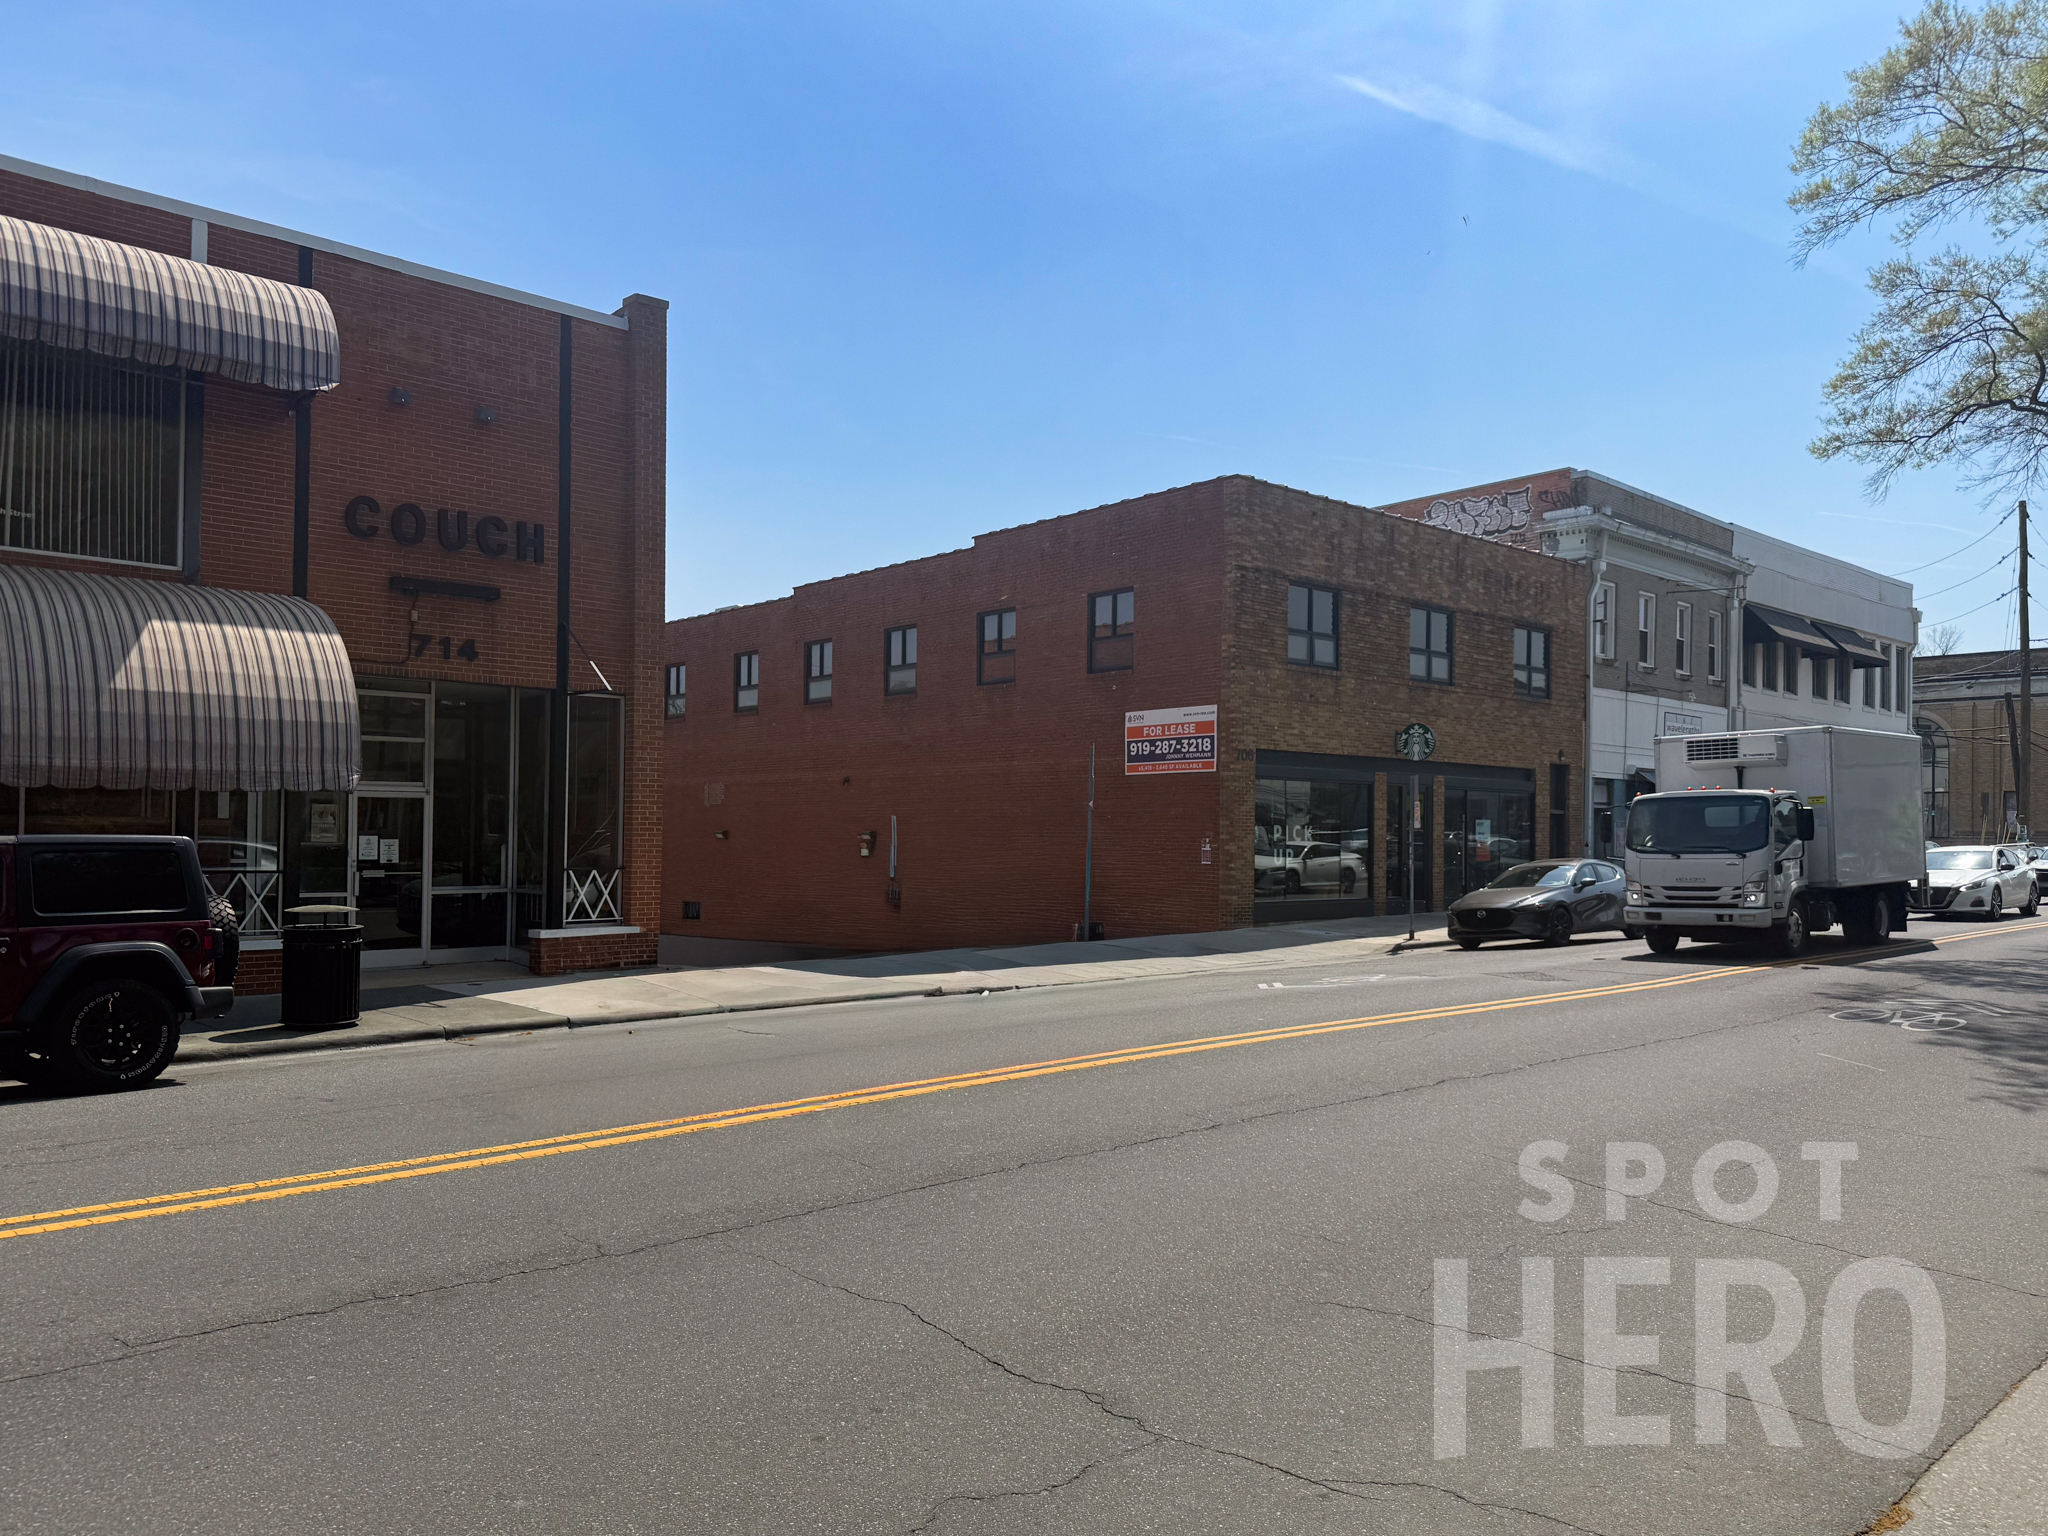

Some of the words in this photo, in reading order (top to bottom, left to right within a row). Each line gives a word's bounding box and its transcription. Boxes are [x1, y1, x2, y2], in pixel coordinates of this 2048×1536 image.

[344, 495, 545, 564] COUCH
[411, 633, 479, 662] 714
[1133, 714, 1145, 723] SVN
[1143, 726, 1162, 736] FOR
[1164, 723, 1196, 735] LEASE
[1129, 737, 1212, 756] 919-287-3218
[1236, 748, 1254, 762] 706
[1273, 824, 1313, 842] PICK
[1273, 848, 1295, 866] UP
